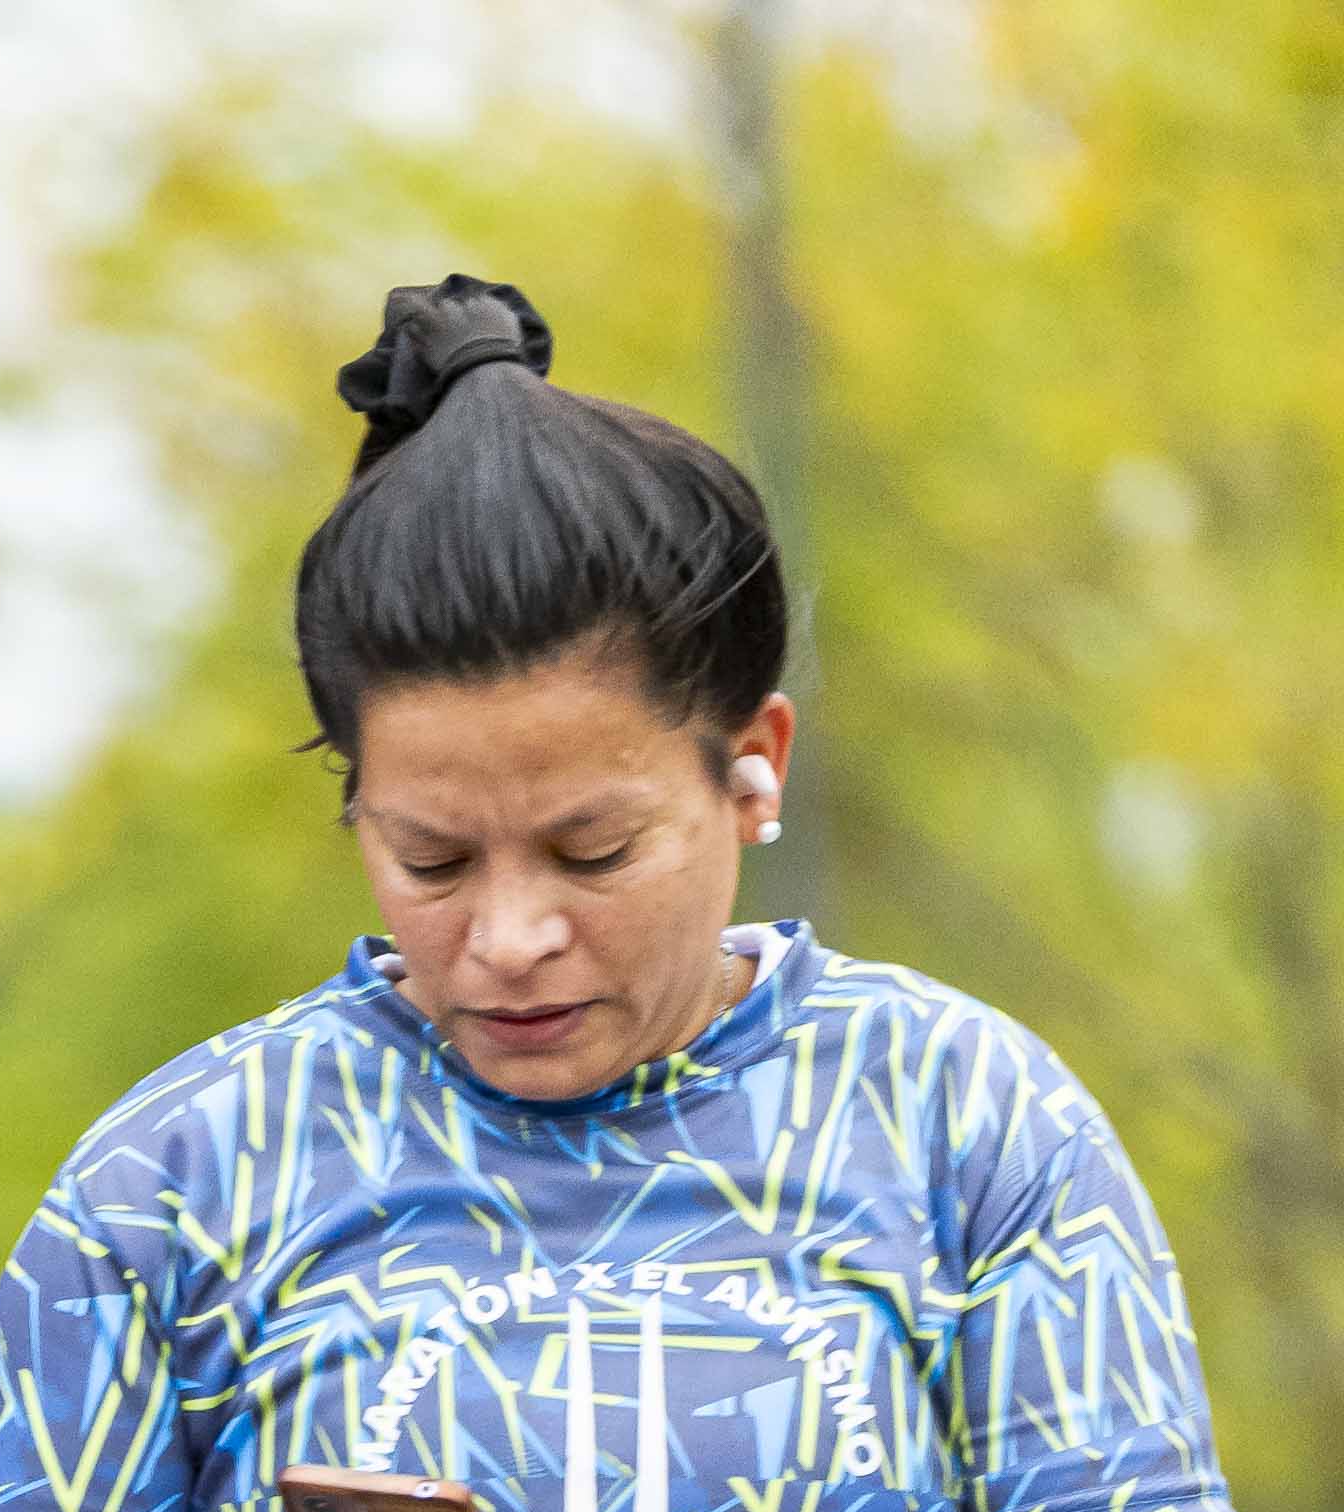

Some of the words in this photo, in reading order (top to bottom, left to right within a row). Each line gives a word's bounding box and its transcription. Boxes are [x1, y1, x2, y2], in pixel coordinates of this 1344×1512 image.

[352, 1267, 558, 1472] MARATÓN
[572, 1262, 616, 1292] X
[630, 1262, 694, 1296] EL
[702, 1275, 883, 1477] AUTISMO
